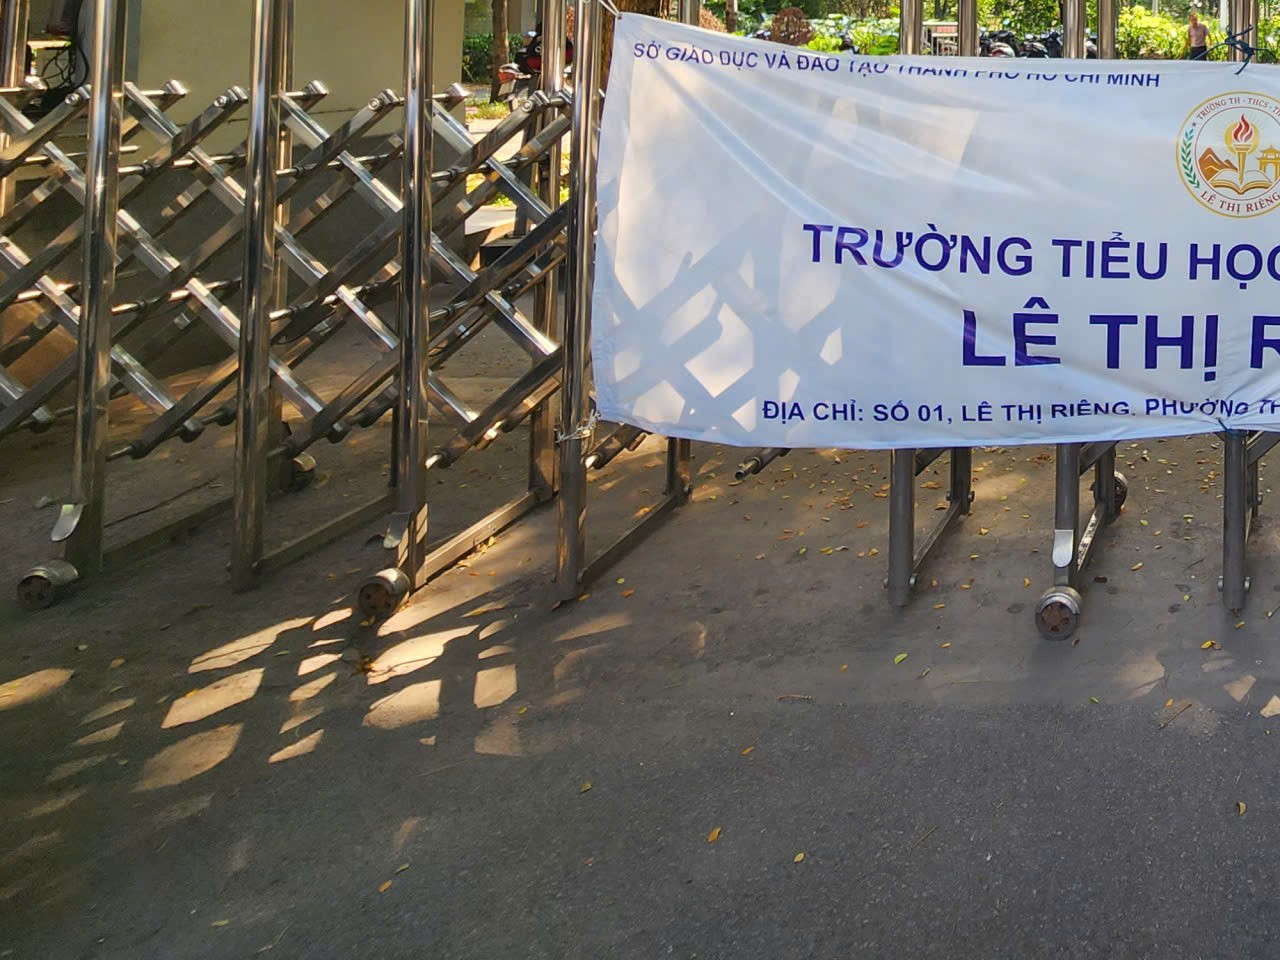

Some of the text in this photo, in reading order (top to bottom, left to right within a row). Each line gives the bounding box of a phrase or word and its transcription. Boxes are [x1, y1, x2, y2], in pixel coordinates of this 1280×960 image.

[719, 51, 758, 70] DỤC
[764, 51, 791, 69] VÀ
[1107, 73, 1160, 87] MINH
[1229, 97, 1241, 105] TH
[1248, 97, 1270, 109] THCS
[1200, 190, 1216, 205] LÊ
[1219, 199, 1241, 215] THỊ
[802, 223, 1034, 277] TRƯỜNG
[1051, 231, 1168, 280] TIỂU
[962, 296, 1062, 368] LÊ
[1089, 314, 1220, 383] THỊ
[762, 400, 805, 425] ĐỊA
[812, 398, 864, 422] CHỈ:
[873, 399, 910, 422] SỐ
[918, 404, 953, 425] 01,
[962, 400, 993, 422] LÊ
[1001, 404, 1042, 425] THỊ
[1145, 398, 1249, 418] PHƯỜNG
